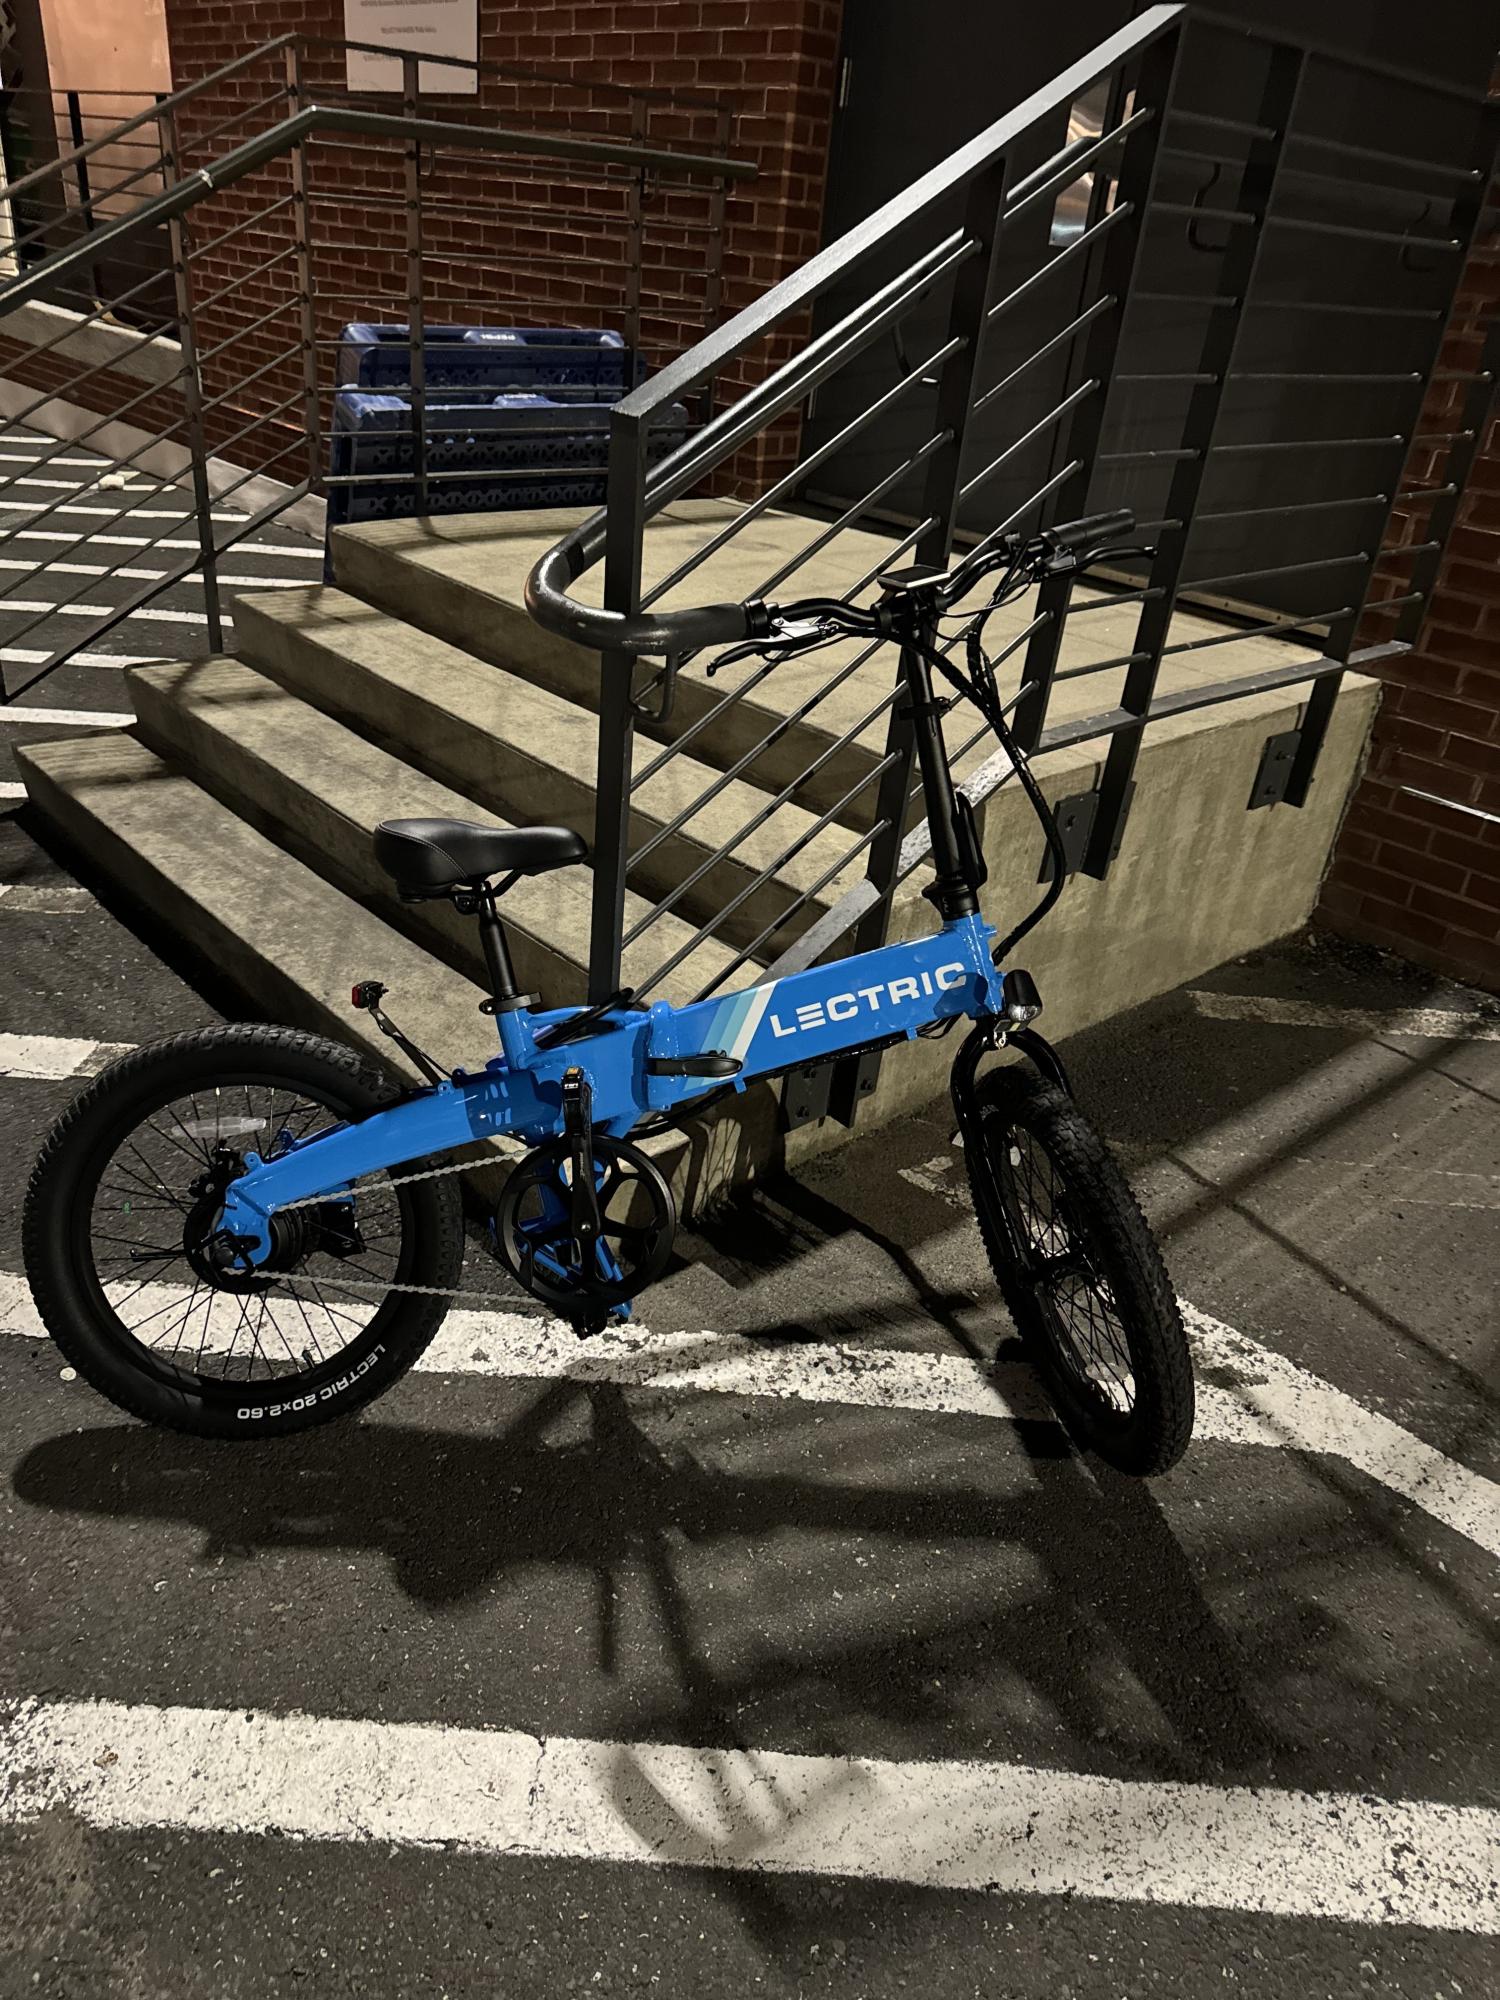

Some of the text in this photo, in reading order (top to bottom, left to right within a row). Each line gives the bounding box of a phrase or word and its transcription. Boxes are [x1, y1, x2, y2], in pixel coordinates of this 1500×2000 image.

[769, 962, 967, 1038] LECTRIC
[237, 1343, 386, 1420] LECTRIC 20x2.60
